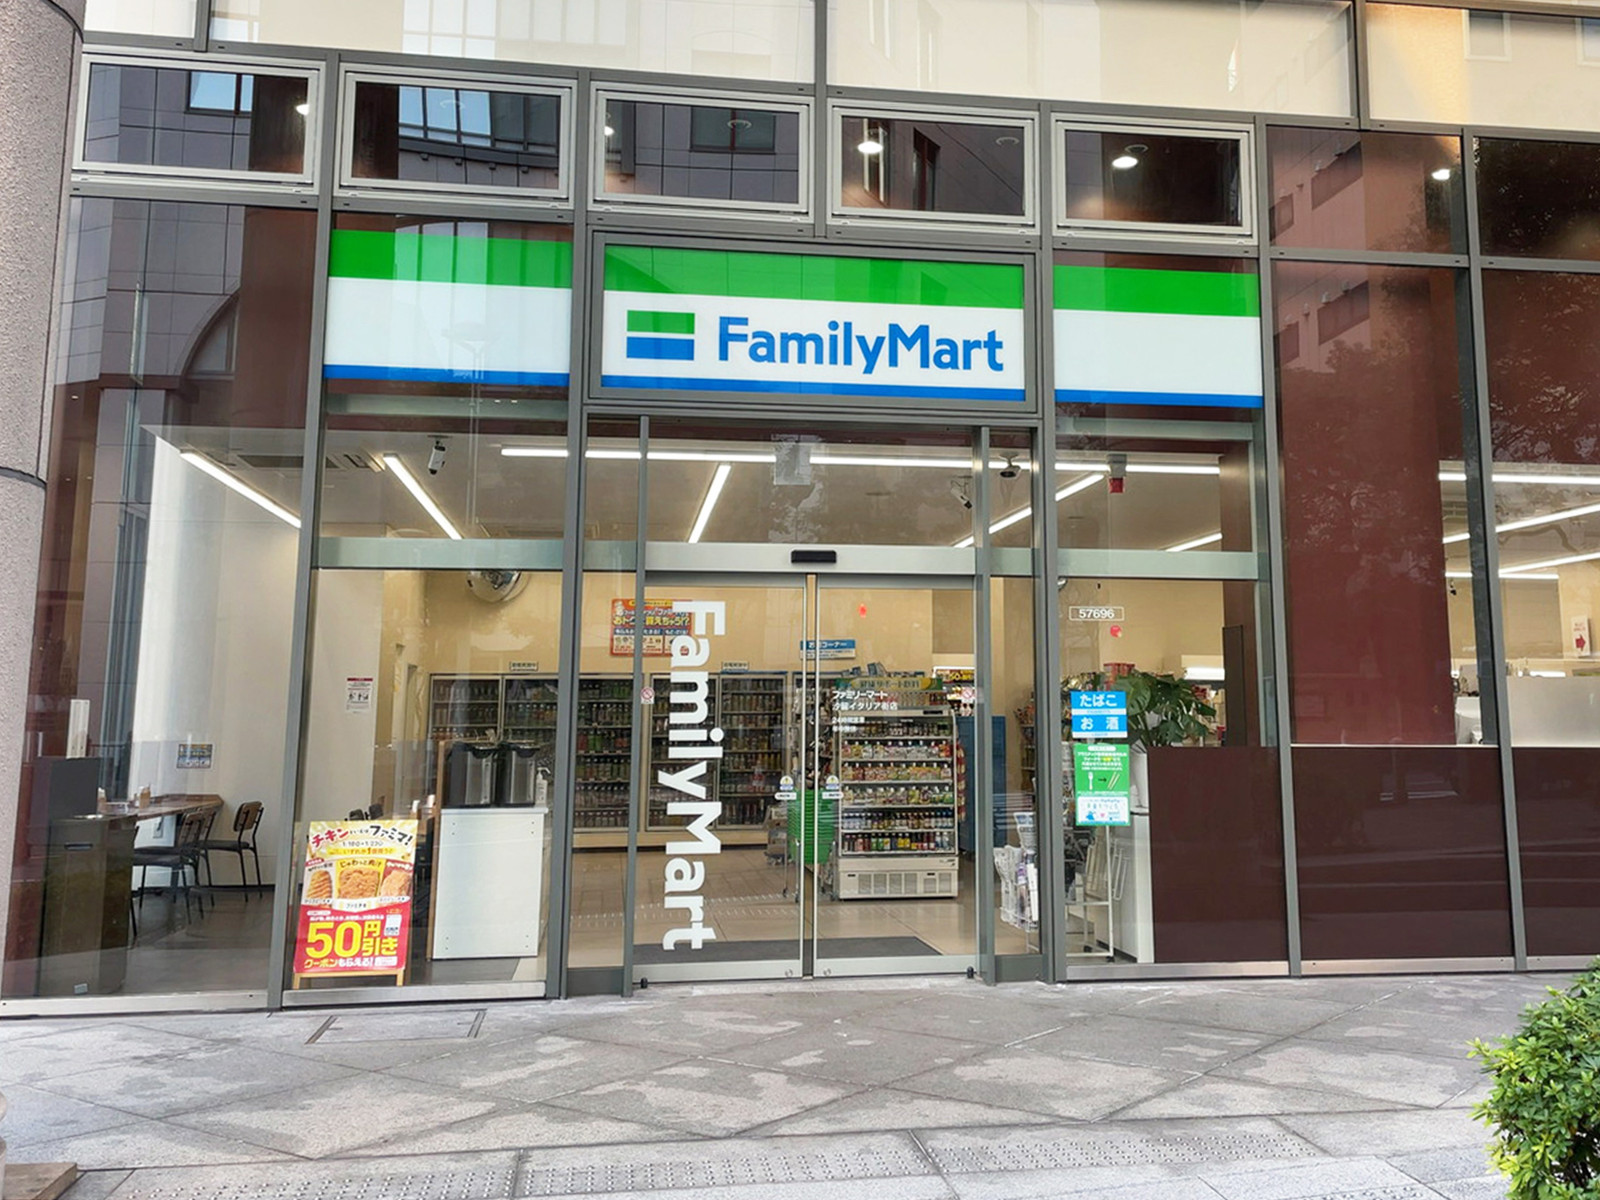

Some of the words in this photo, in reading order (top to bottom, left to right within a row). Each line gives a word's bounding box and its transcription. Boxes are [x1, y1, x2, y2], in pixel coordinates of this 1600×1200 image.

[719, 316, 1004, 374] FamilyMart
[1079, 608, 1115, 619] 57696
[832, 690, 888, 699] ファミリーマート
[1079, 694, 1118, 707] たばこ
[658, 601, 726, 951] FamilyMart
